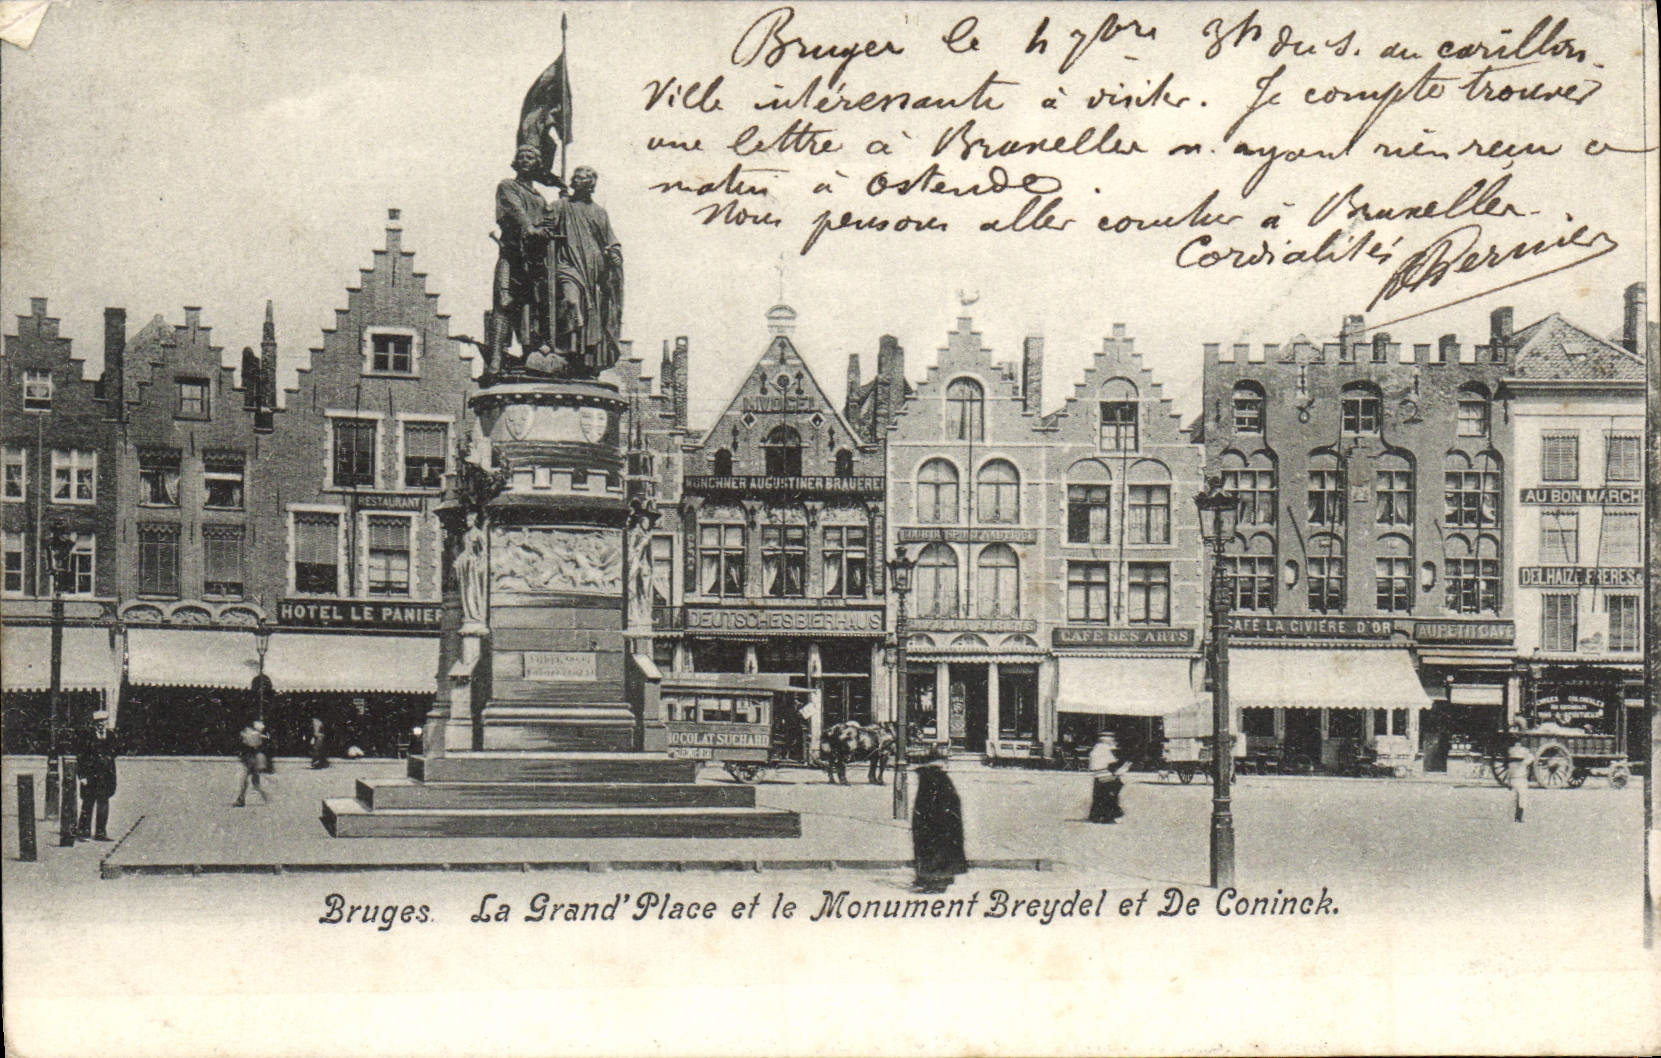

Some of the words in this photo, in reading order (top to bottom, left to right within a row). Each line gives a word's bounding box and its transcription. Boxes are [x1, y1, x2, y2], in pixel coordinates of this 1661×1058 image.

[942, 16, 981, 54] le
[644, 76, 724, 113] Ville
[754, 70, 1020, 113] intéressante
[1041, 86, 1067, 110] à
[1304, 63, 1462, 152] compte
[646, 137, 704, 153] une
[727, 119, 847, 156] lettre
[750, 477, 825, 490] AUGUSTINER
[826, 477, 885, 491] BRAUEREI
[358, 496, 420, 508] RESTAURANT
[1525, 489, 1547, 502] AU
[1551, 489, 1582, 502] BON
[281, 603, 344, 620] HOTEL
[351, 606, 375, 621] LE
[1266, 619, 1284, 632] LA
[1144, 629, 1189, 643] ARTS
[716, 733, 770, 747] SUCHARD
